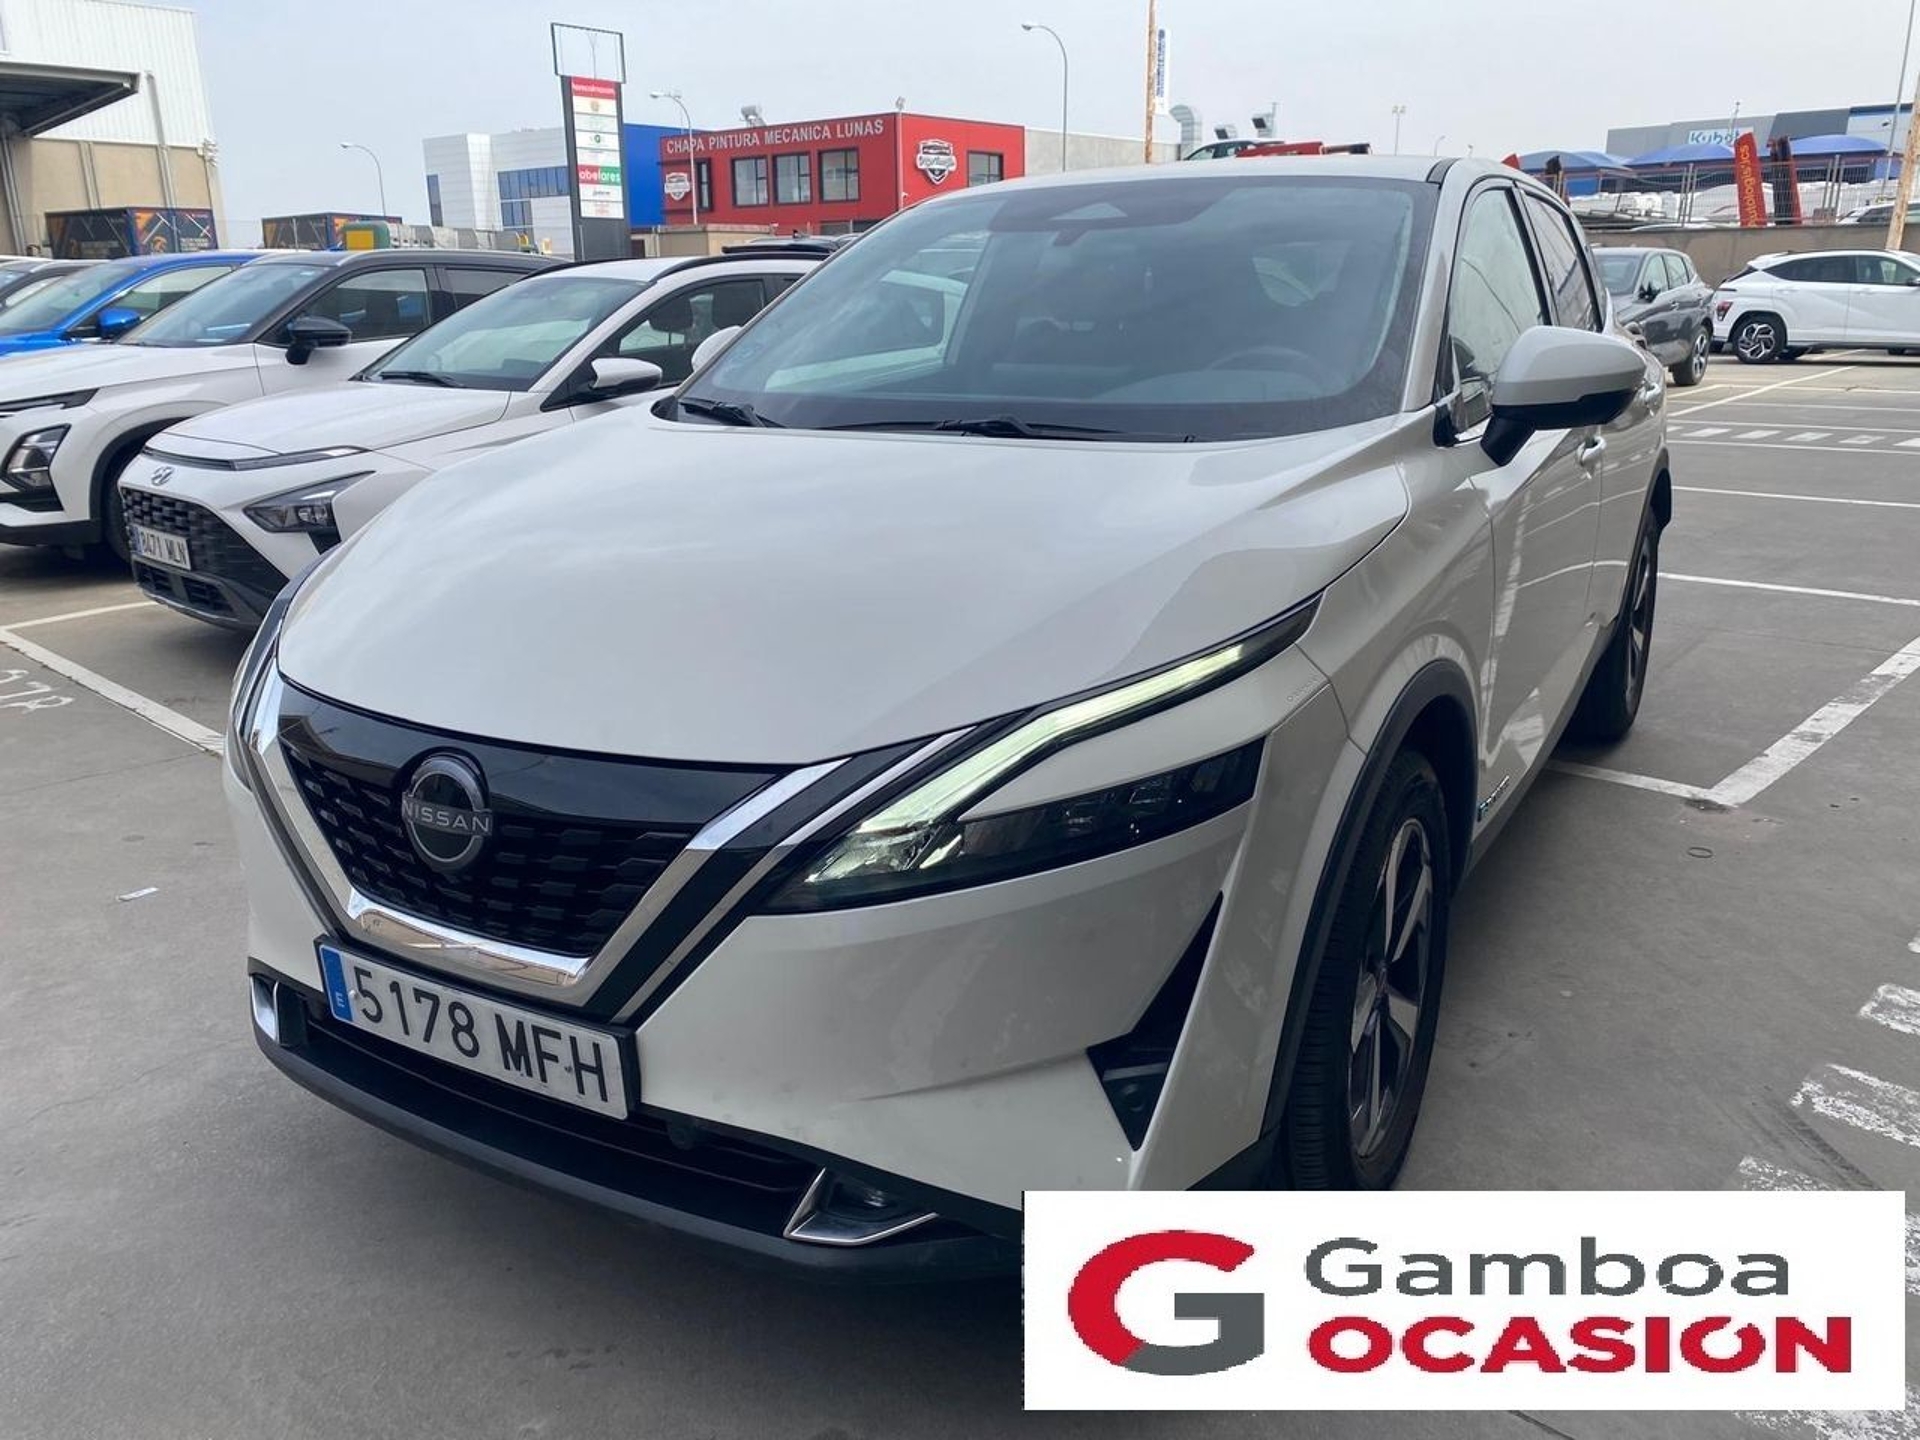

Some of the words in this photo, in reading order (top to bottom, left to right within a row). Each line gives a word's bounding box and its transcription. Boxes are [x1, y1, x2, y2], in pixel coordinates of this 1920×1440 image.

[667, 137, 704, 153] CHAPA
[708, 132, 760, 150] PINTURA
[764, 125, 832, 145] MECANICA
[836, 119, 885, 138] LUNAS
[401, 799, 490, 832] NISSAN
[335, 991, 346, 1008] E
[353, 966, 480, 1058] 5178
[494, 1013, 609, 1102] MFH
